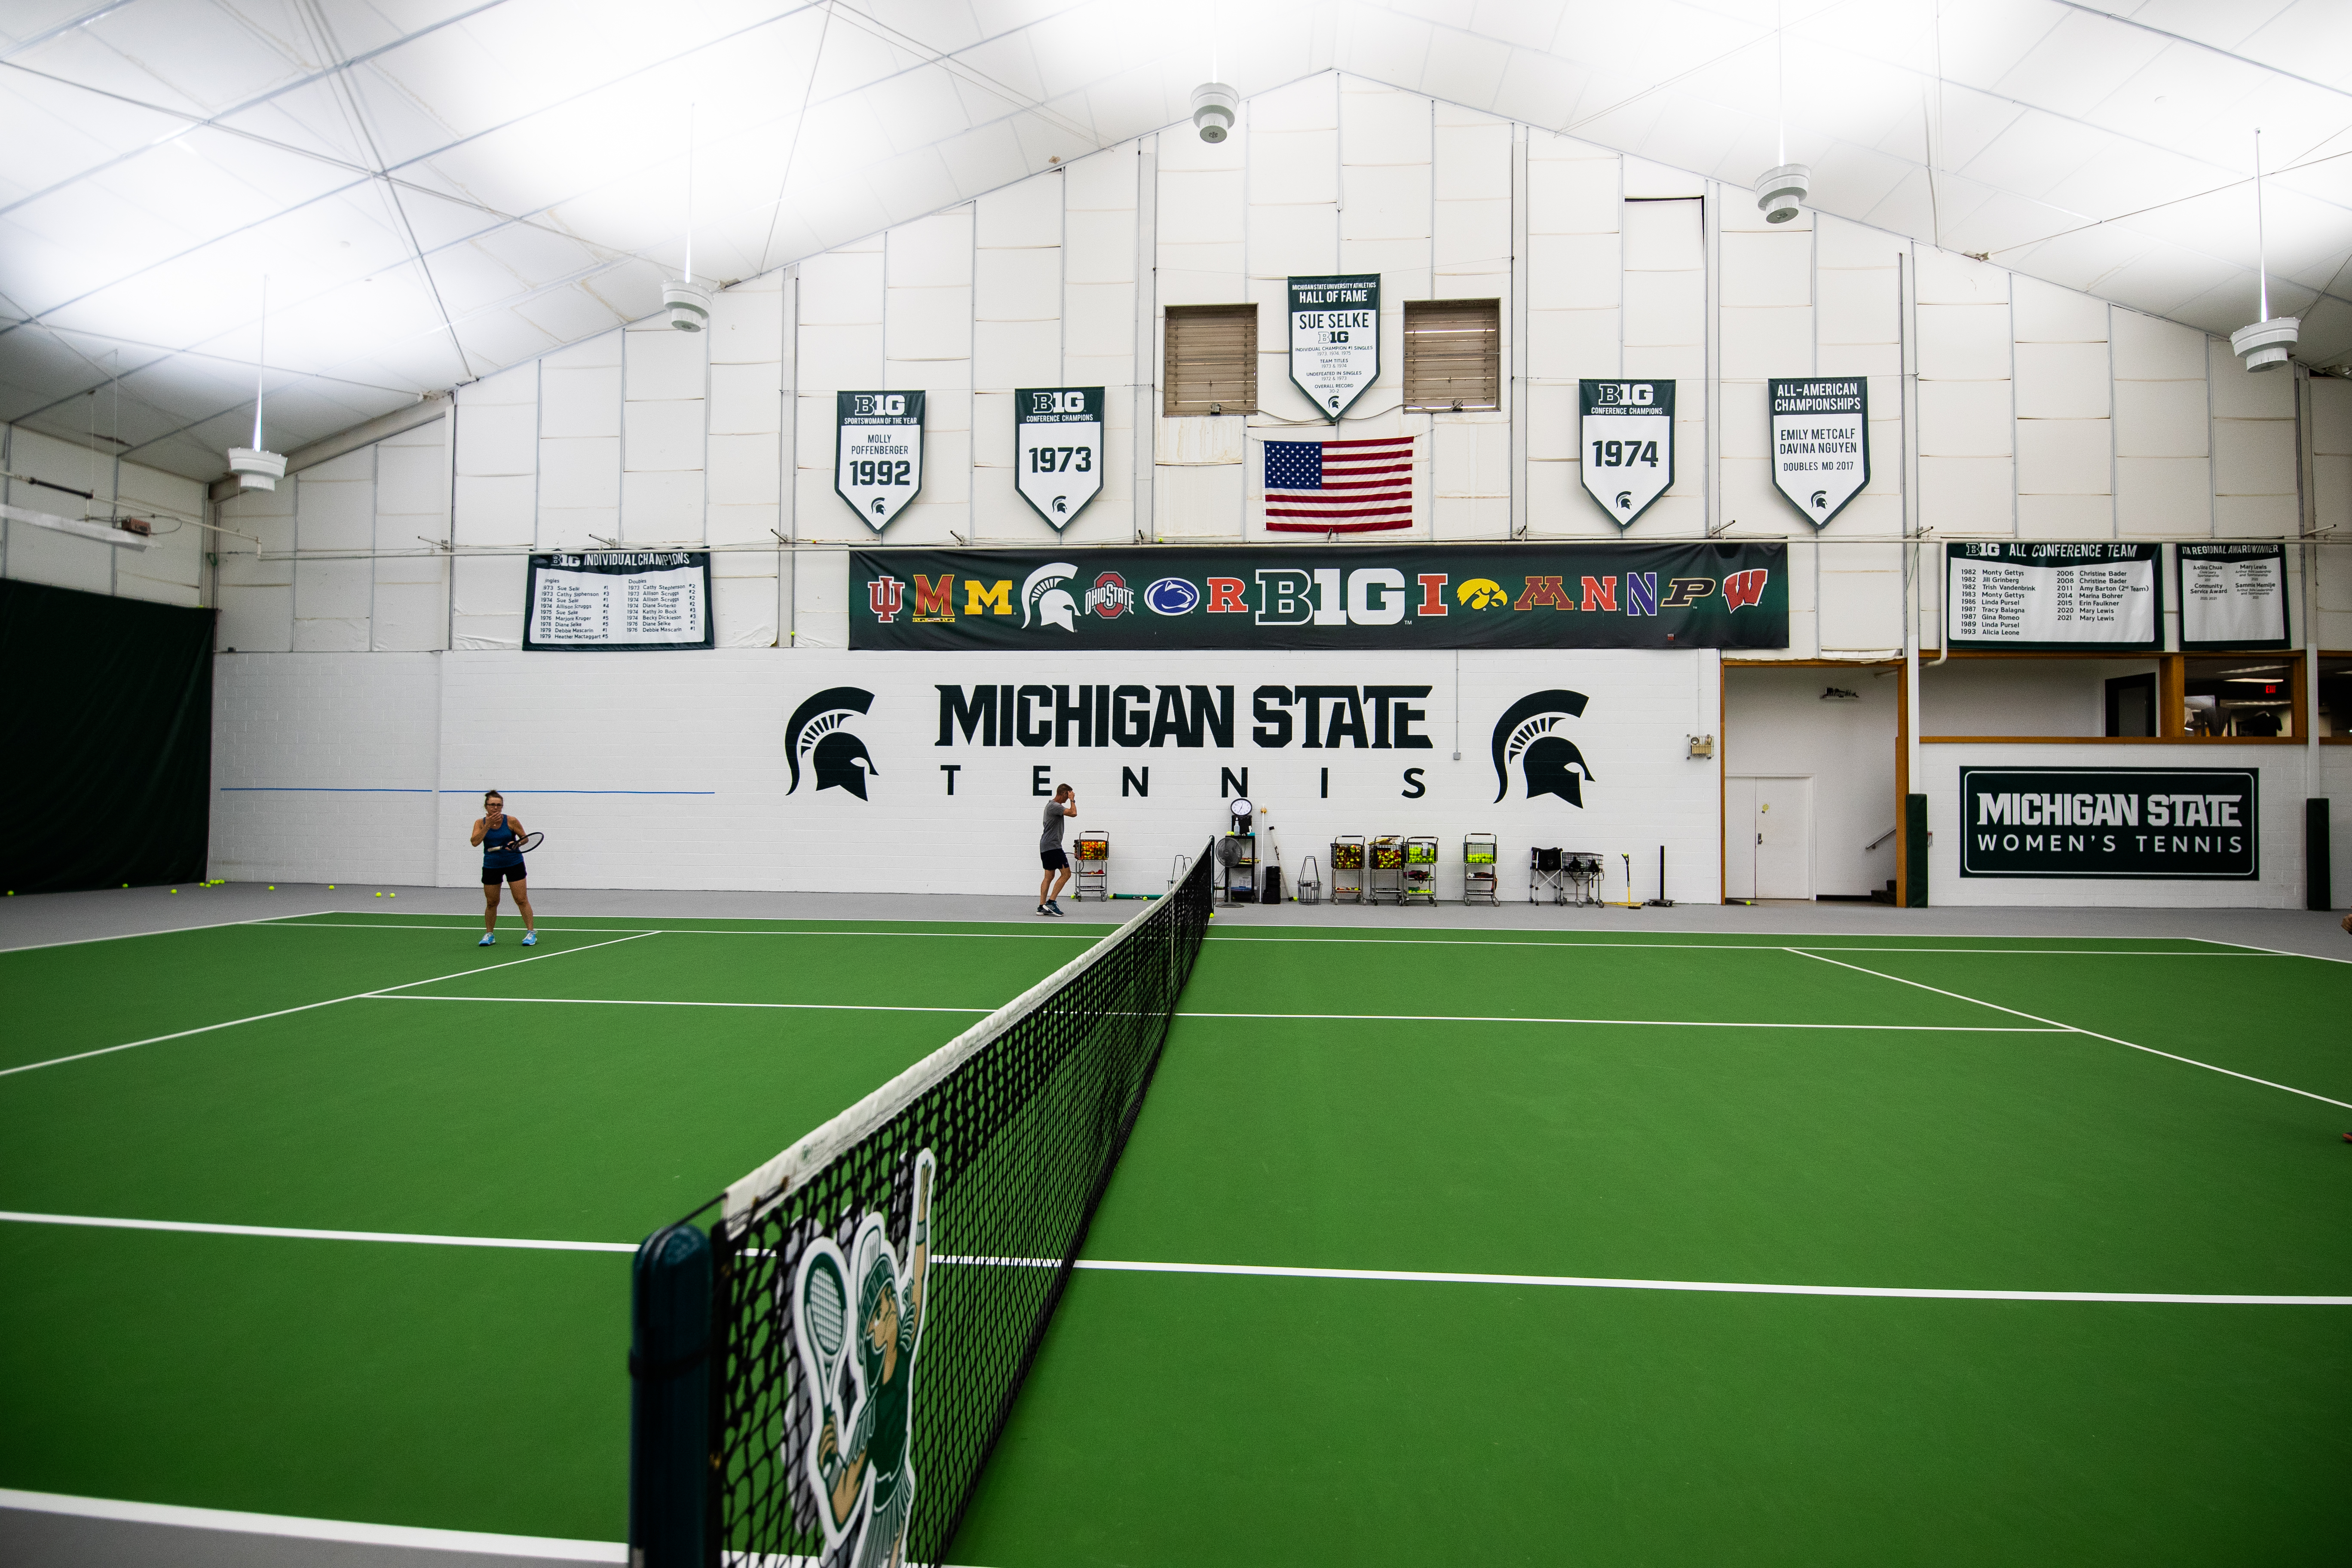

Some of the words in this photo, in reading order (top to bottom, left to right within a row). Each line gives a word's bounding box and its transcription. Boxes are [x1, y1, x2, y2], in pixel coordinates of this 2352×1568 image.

[1300, 291, 1324, 303] HALL
[1327, 291, 1338, 302] OF
[1341, 290, 1367, 302] FAME
[1299, 314, 1324, 329] SUE
[1329, 312, 1369, 328] SELKE
[1777, 383, 1857, 396] ALL-AMERICAN
[1775, 397, 1860, 411] CHAMPIONSHIPS
[868, 435, 891, 443] MOLLY
[1781, 429, 1808, 441] EMILY
[1812, 429, 1855, 439] METCALF
[851, 446, 908, 454] POFFENBERGER
[1592, 441, 1658, 467] 1974
[1780, 443, 1815, 454] DAVINA
[1819, 442, 1856, 453] NGUYEN
[1029, 447, 1091, 473] 1973
[1784, 462, 1818, 471] DOUBLES
[1822, 462, 1833, 470] MD
[1837, 461, 1853, 470] 2017
[850, 461, 910, 486] 1992
[2009, 544, 2027, 557] ALL
[2031, 544, 2101, 557] CONFERENCE
[2107, 545, 2138, 557] TEAM
[2192, 545, 2226, 554] REGIONAL
[584, 553, 637, 566] INDIVIDUAL
[637, 552, 690, 566] CHAMPIONS
[1207, 577, 1249, 612] R
[935, 685, 1234, 747] MICHIGAN
[1252, 685, 1433, 749] STATE
[940, 765, 1425, 799] TENNIS
[1977, 793, 2138, 826] MICHIGAN
[2148, 795, 2242, 827] STATE
[1978, 834, 2115, 851] WOMEN'S
[2136, 836, 2241, 853] TENNIS
